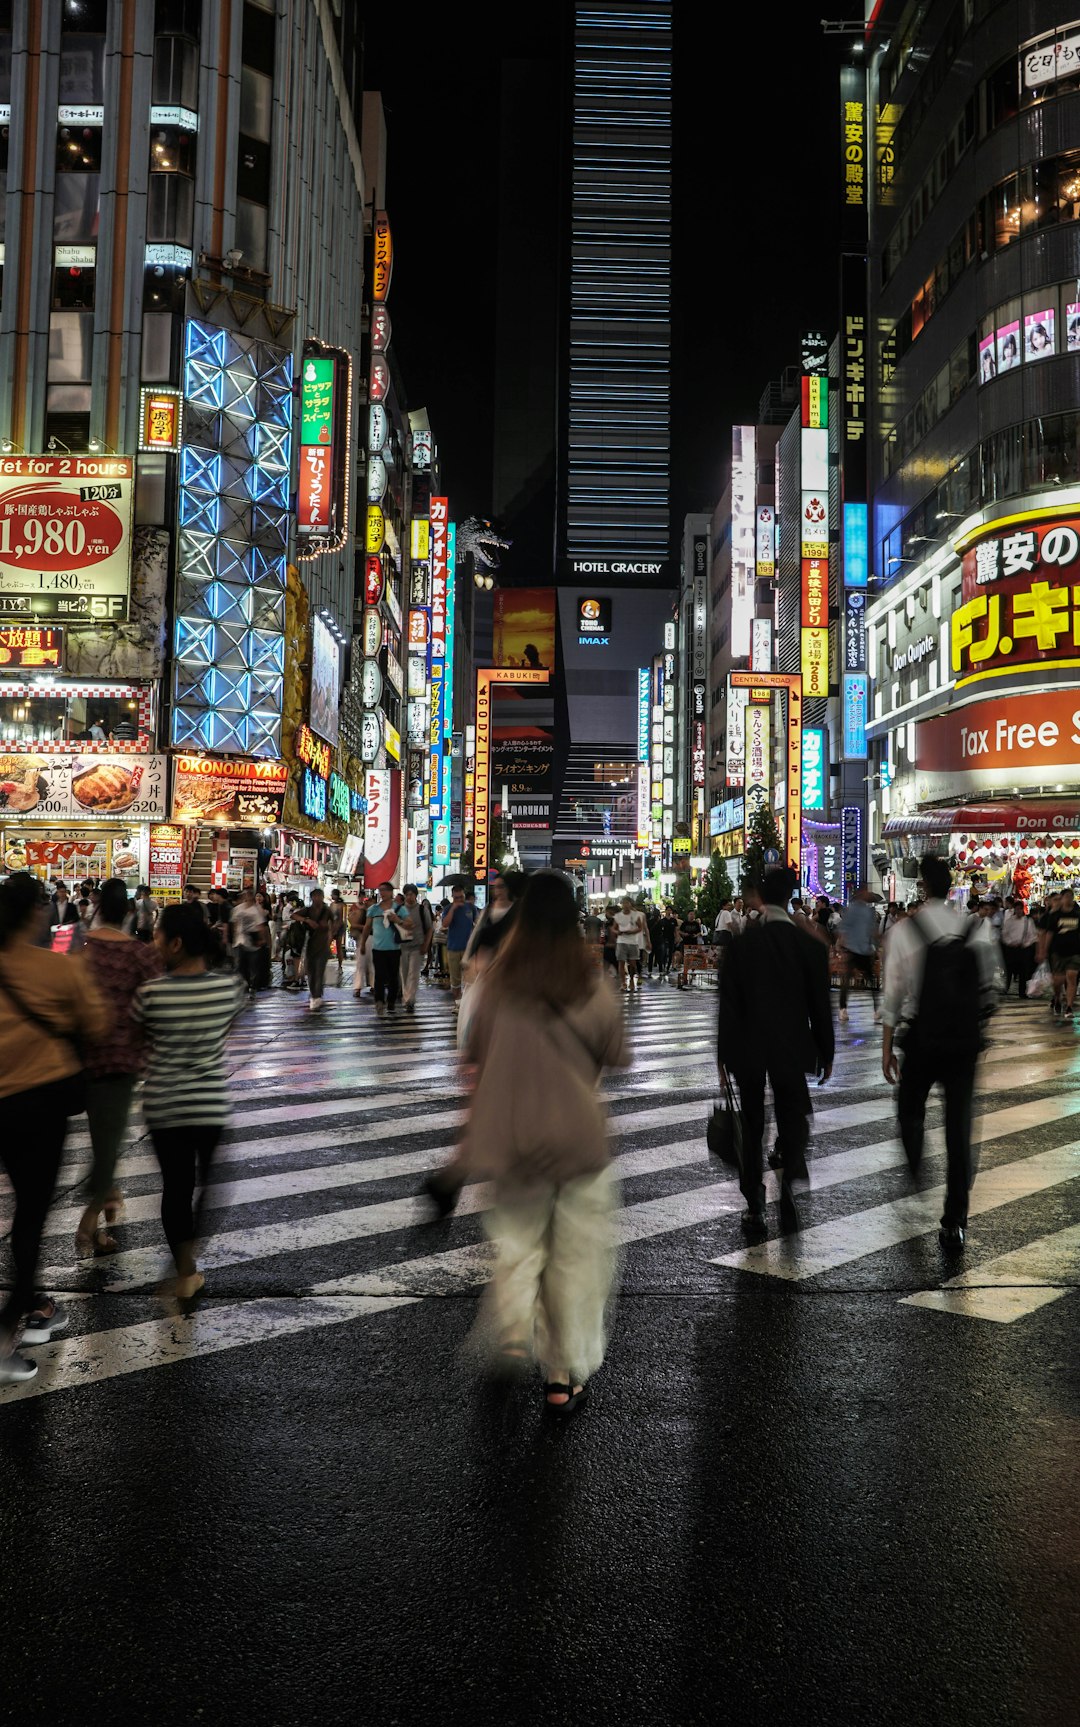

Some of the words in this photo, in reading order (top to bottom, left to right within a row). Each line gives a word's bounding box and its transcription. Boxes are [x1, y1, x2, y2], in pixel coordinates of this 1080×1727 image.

[846, 102, 863, 205] 驚安の殿堂
[57, 247, 80, 255] Shabu
[71, 255, 93, 263] Shabu
[28, 459, 54, 474] for
[60, 460, 71, 474] 2
[76, 459, 127, 475] hours
[83, 486, 119, 501] 120分
[306, 457, 325, 523] ひょうたん
[0, 518, 86, 560] 1,980
[87, 545, 110, 556] yen
[976, 527, 1079, 585] 驚安の
[574, 561, 610, 573] HOTEL
[611, 562, 662, 574] GRACERY
[38, 573, 78, 590] 1,480
[78, 580, 95, 591] yen
[91, 597, 123, 617] 5F
[579, 637, 608, 646] IMAX
[893, 653, 907, 672] Don
[907, 634, 934, 664] Quijote
[734, 676, 768, 684] CENTRAL
[770, 676, 791, 684] ROAD
[810, 666, 820, 691] 280
[476, 699, 487, 794] GODZILLA
[961, 727, 989, 758] Tax
[995, 718, 1060, 752] Free
[59, 757, 69, 800] とんこつ
[148, 757, 162, 799] かつ丼
[178, 759, 250, 777] OKONOMI
[254, 763, 288, 779] YAKI
[495, 763, 550, 776] ライオン・キング
[802, 738, 821, 806] カラオケ
[37, 801, 68, 813] 500円
[132, 801, 164, 813] 520円
[368, 775, 381, 828] トラノコ
[475, 805, 487, 849] ROAD
[1016, 816, 1047, 828] Don
[845, 811, 857, 869] カラオケ
[591, 847, 613, 856] TOHO
[824, 844, 836, 893] カラオケ
[845, 872, 857, 881] B1
